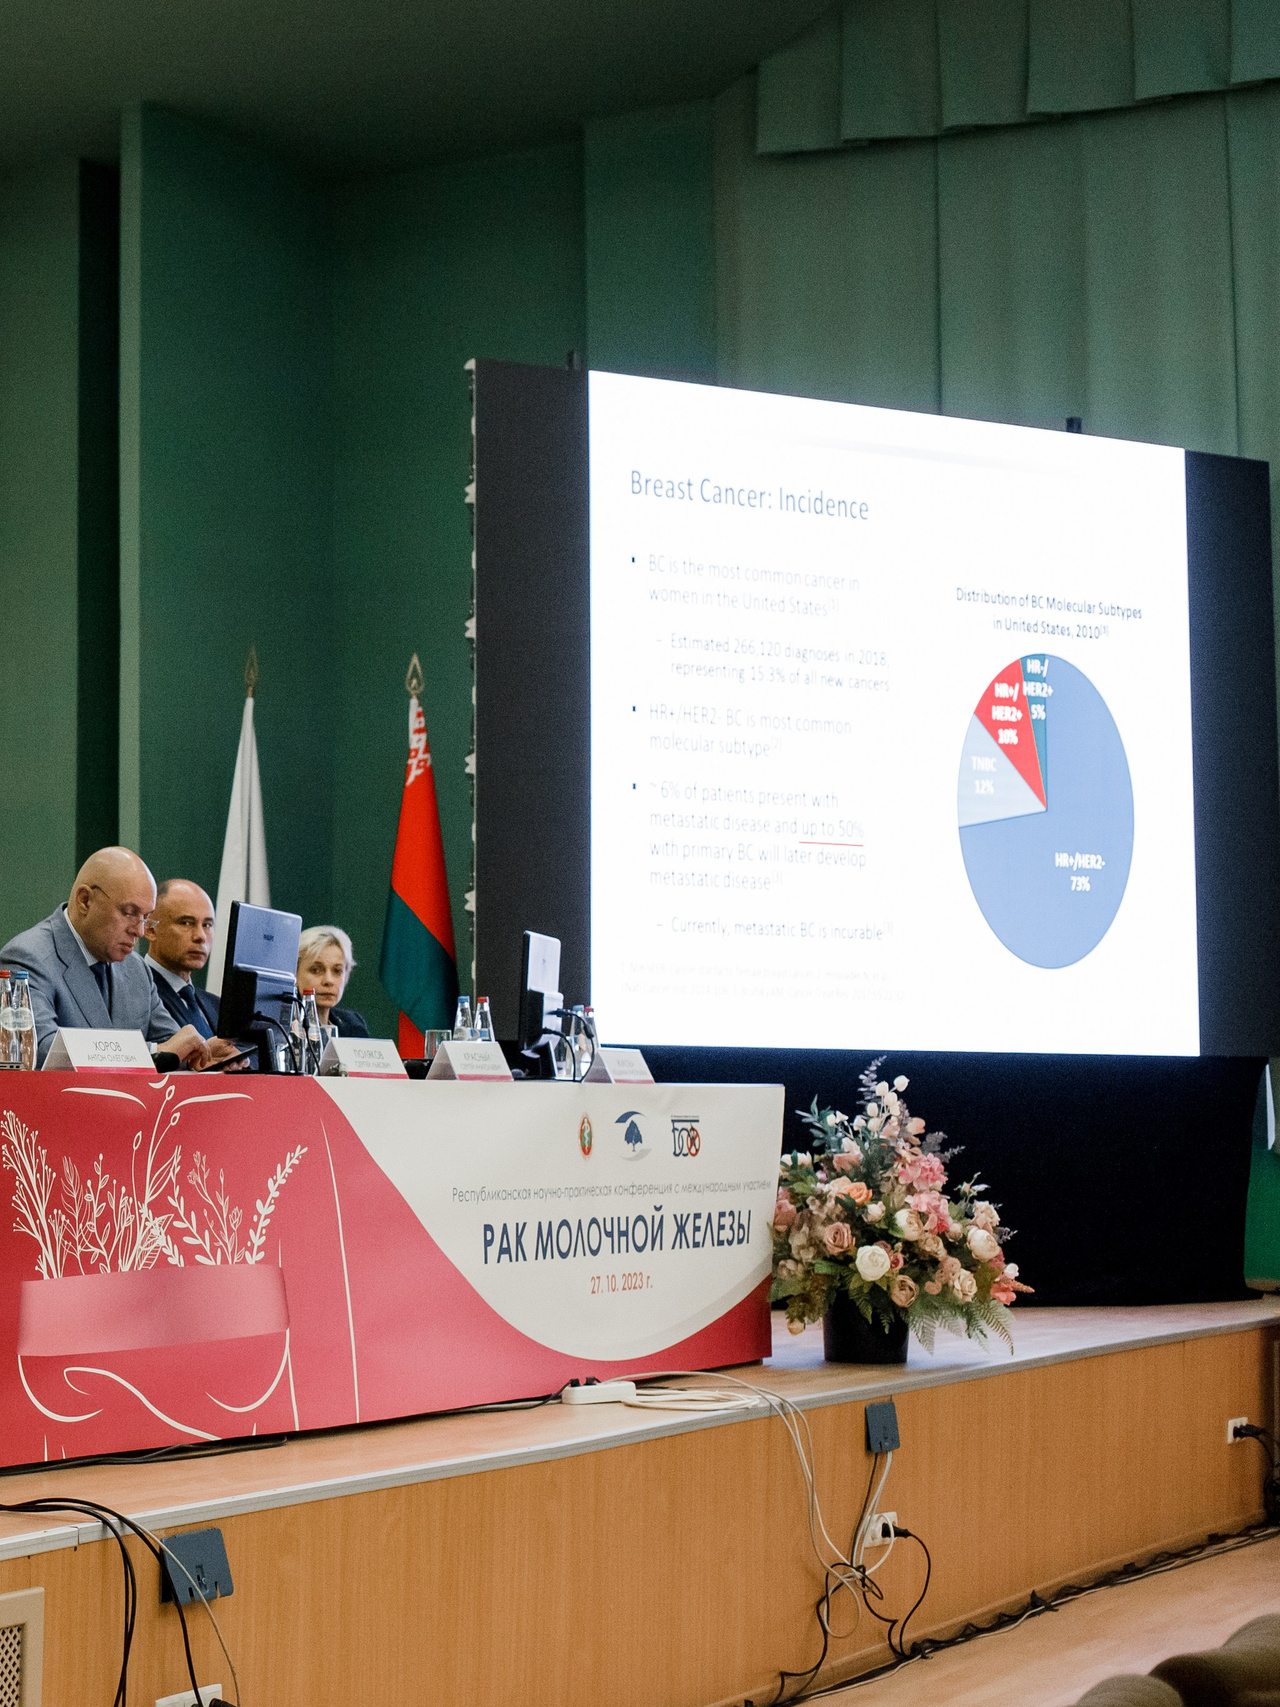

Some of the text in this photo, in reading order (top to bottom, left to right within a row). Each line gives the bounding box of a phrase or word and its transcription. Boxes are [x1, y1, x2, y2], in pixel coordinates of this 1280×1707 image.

[631, 470, 869, 520] Breast Cancer: Incidence
[649, 554, 860, 592] BC is the most common cancer in
[649, 588, 698, 605] women
[702, 588, 713, 606] in
[717, 591, 738, 608] the
[743, 592, 786, 613] United
[956, 587, 1143, 621] Distribution of BC Molecular Subtypes
[993, 615, 1002, 630] in
[1005, 618, 1039, 634] United
[1041, 620, 1074, 639] States,
[671, 632, 730, 653] Estimated
[784, 643, 840, 663] diagnoses
[845, 647, 855, 663] in
[671, 662, 745, 683] representing
[789, 668, 800, 684] of
[804, 669, 817, 685] all
[821, 674, 844, 687] new
[848, 675, 891, 692] cancers
[726, 708, 743, 727] BC
[747, 711, 756, 728] is
[760, 715, 792, 730] most
[796, 718, 852, 735] common
[1031, 704, 1046, 720] 5%
[649, 733, 715, 753] molecular
[998, 729, 1018, 745] 10%
[972, 756, 997, 772] TNBC
[661, 781, 681, 799] 6%
[684, 782, 698, 800] of
[702, 787, 755, 805] patients
[758, 791, 808, 807] present
[812, 791, 839, 809] with
[975, 780, 994, 795] 12%
[650, 812, 865, 838] metastatic disease and up to 50%
[650, 840, 867, 869] with primary BC will later develop
[650, 871, 719, 889] metastatic
[1071, 876, 1090, 892] 73%
[671, 916, 730, 938] Currently,
[734, 921, 796, 937] metastatic
[800, 921, 815, 938] BC
[819, 921, 827, 939] is
[93, 1041, 122, 1052] ХОРОВ
[452, 1187, 532, 1202] Республиканская
[533, 1185, 612, 1202] научно-практическая
[614, 1182, 673, 1197] конференция
[675, 1185, 680, 1194] с
[681, 1180, 741, 1195] международным
[483, 1205, 751, 1265] РАК МОЛОЧНОЙ ЖЕЛЕЗЫ
[591, 1276, 604, 1294] 27.
[606, 1274, 619, 1292] 10.
[622, 1272, 643, 1291] 2023
